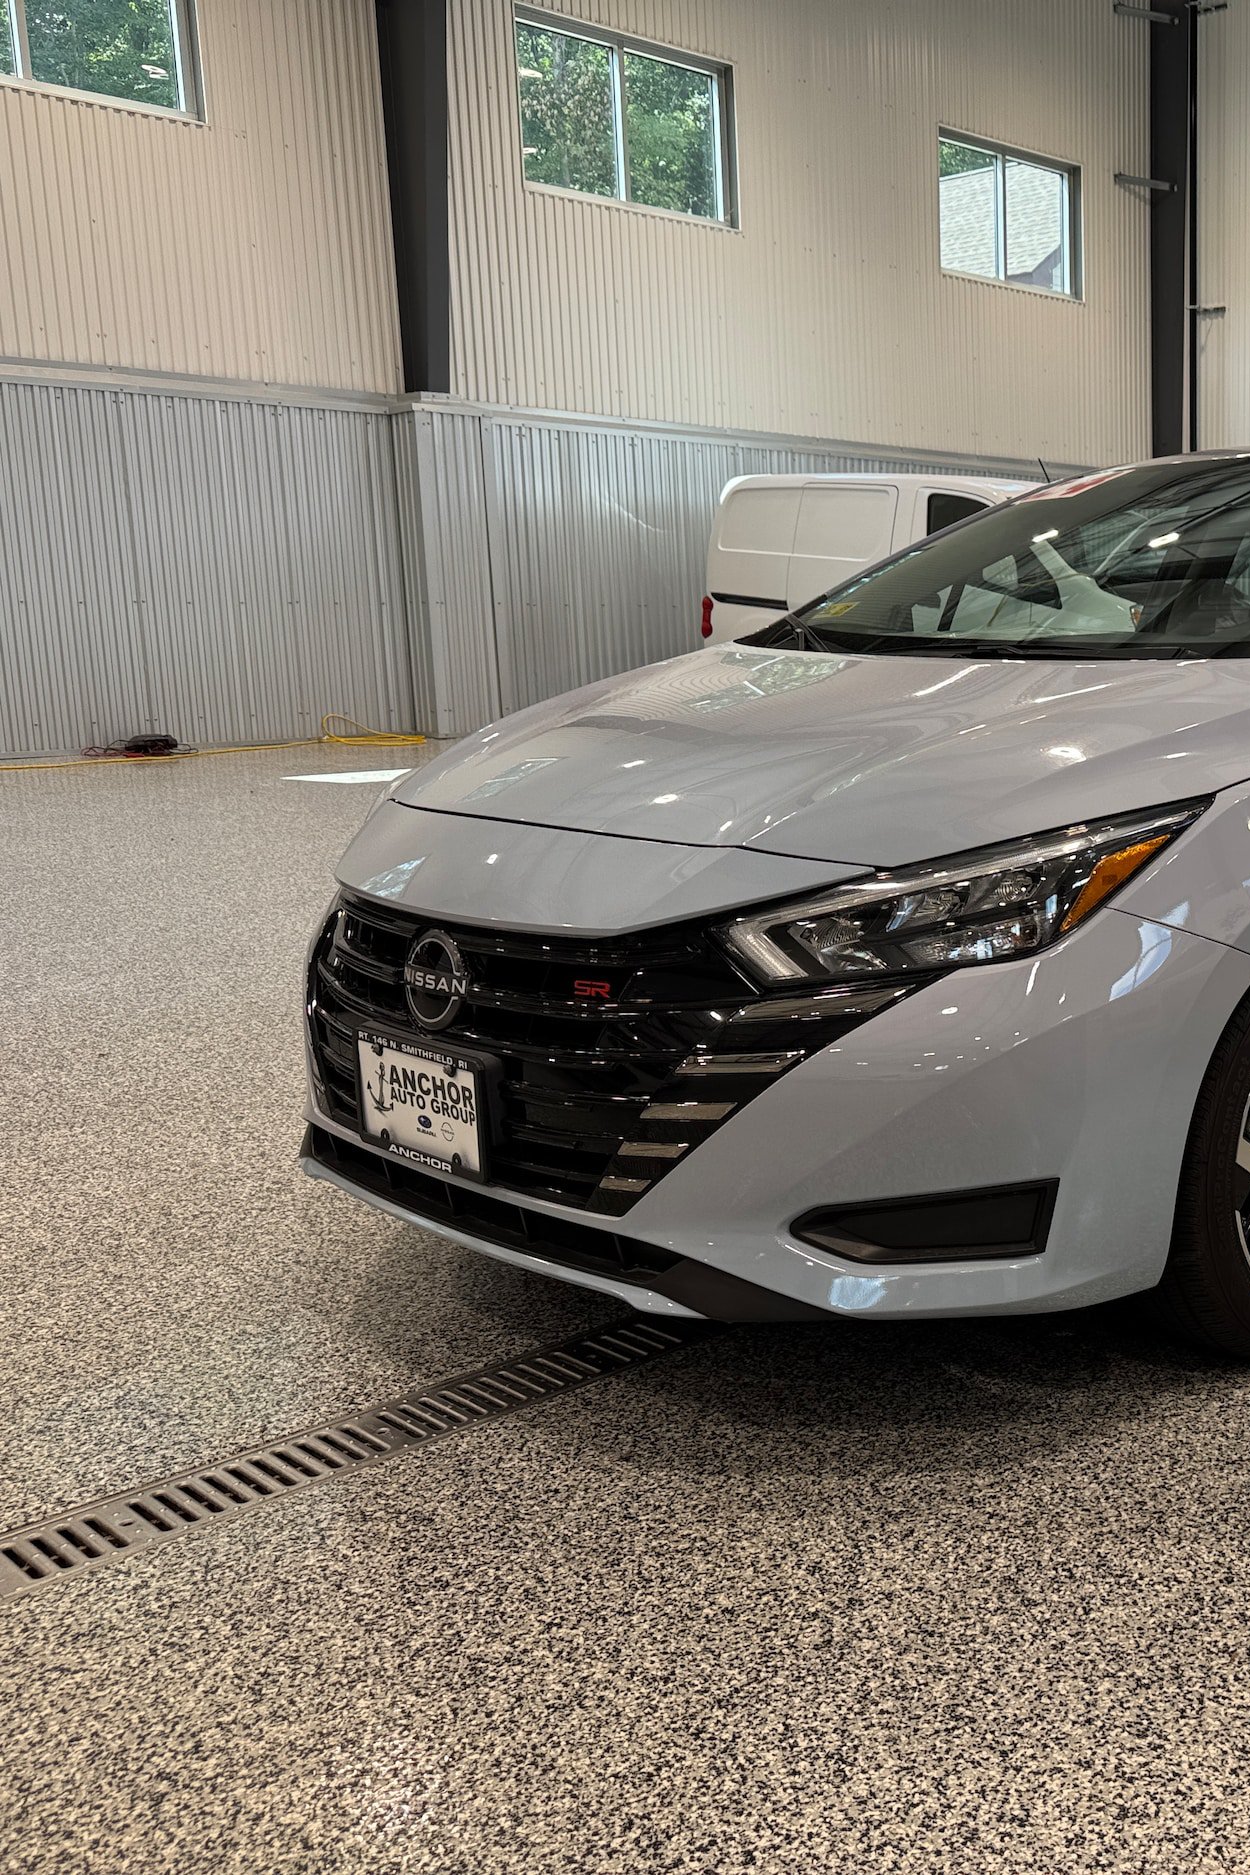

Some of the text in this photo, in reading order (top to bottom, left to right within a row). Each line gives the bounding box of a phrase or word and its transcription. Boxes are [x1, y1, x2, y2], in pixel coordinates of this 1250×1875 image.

[404, 966, 466, 995] NISSAN
[574, 980, 610, 998] SR
[358, 1030, 370, 1041] RT.
[372, 1035, 388, 1047] 146
[390, 1040, 399, 1050] N.
[458, 1060, 468, 1070] RI
[390, 1064, 475, 1111] ANCHOR
[390, 1086, 476, 1126] AUTO GROUP
[388, 1142, 453, 1174] ANCHOR
